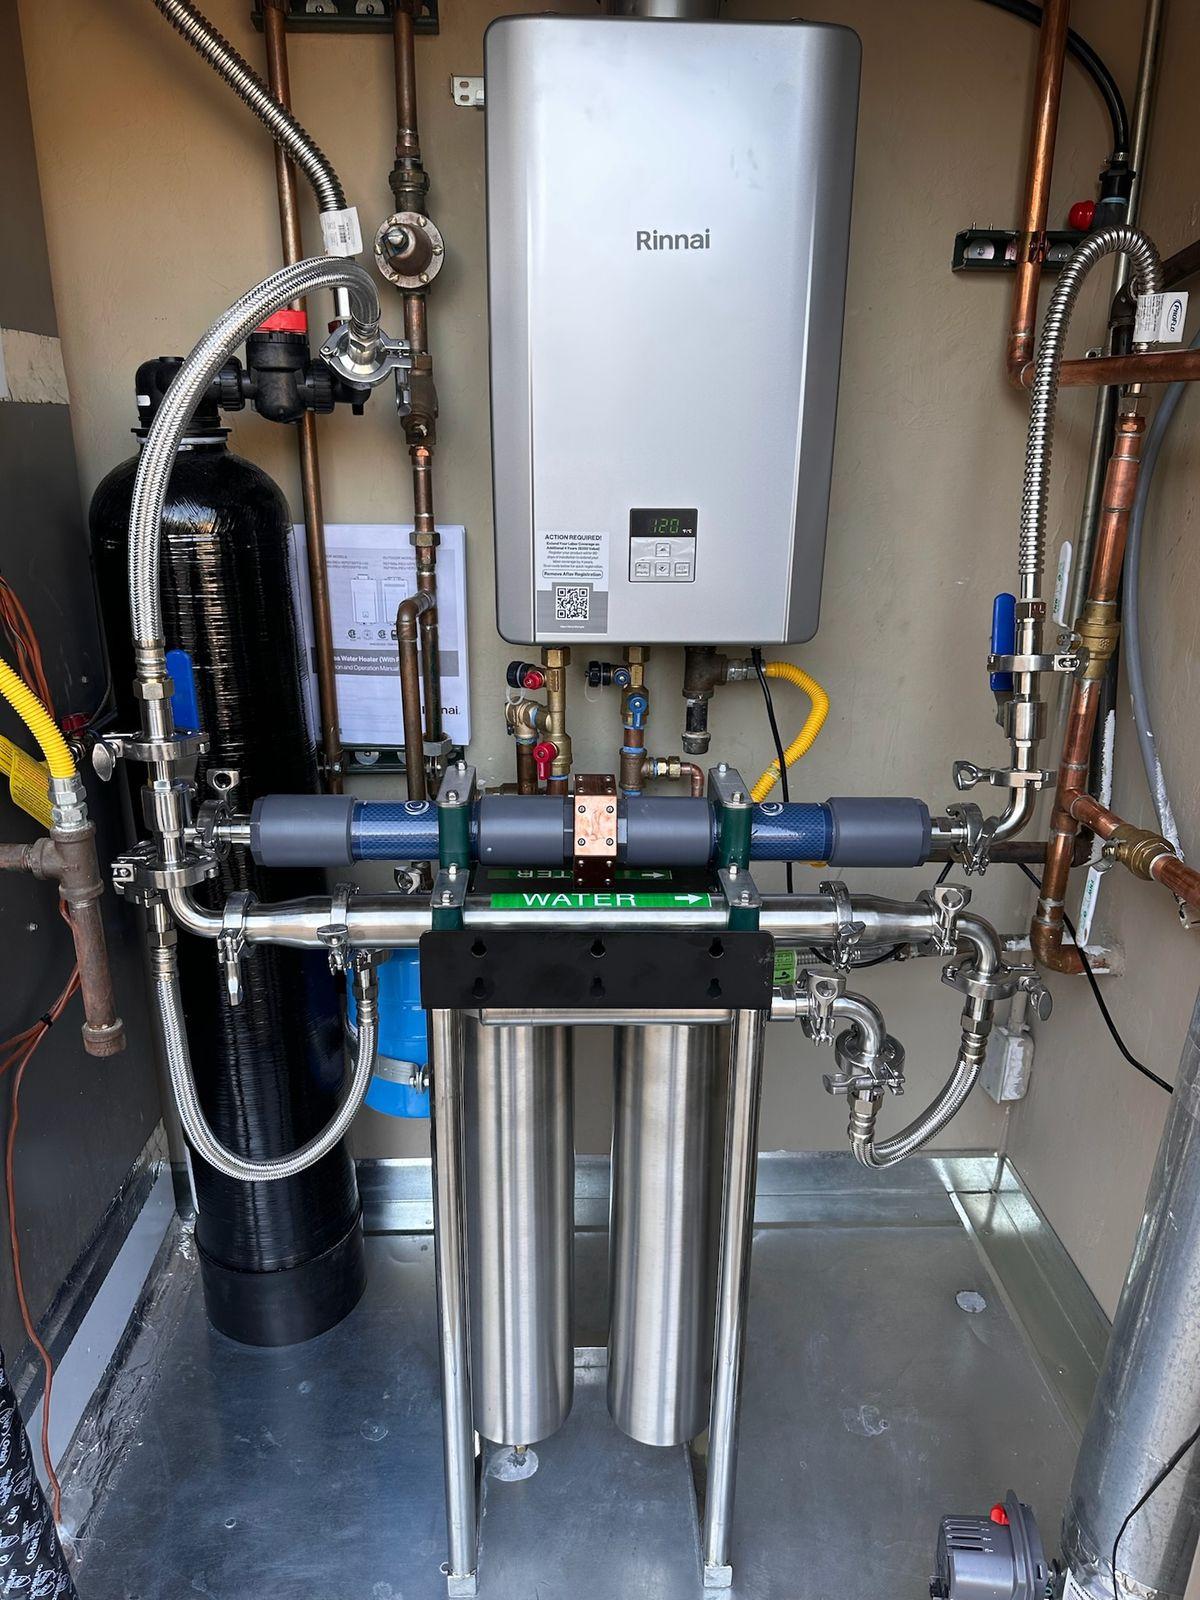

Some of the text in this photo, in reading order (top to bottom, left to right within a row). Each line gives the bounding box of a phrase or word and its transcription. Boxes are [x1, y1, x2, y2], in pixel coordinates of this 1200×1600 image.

[637, 229, 710, 250] Rinnai
[652, 518, 680, 534] 120
[358, 655, 378, 663] Heater
[522, 893, 637, 906] WATER
[26, 1537, 40, 1560] Orbit
